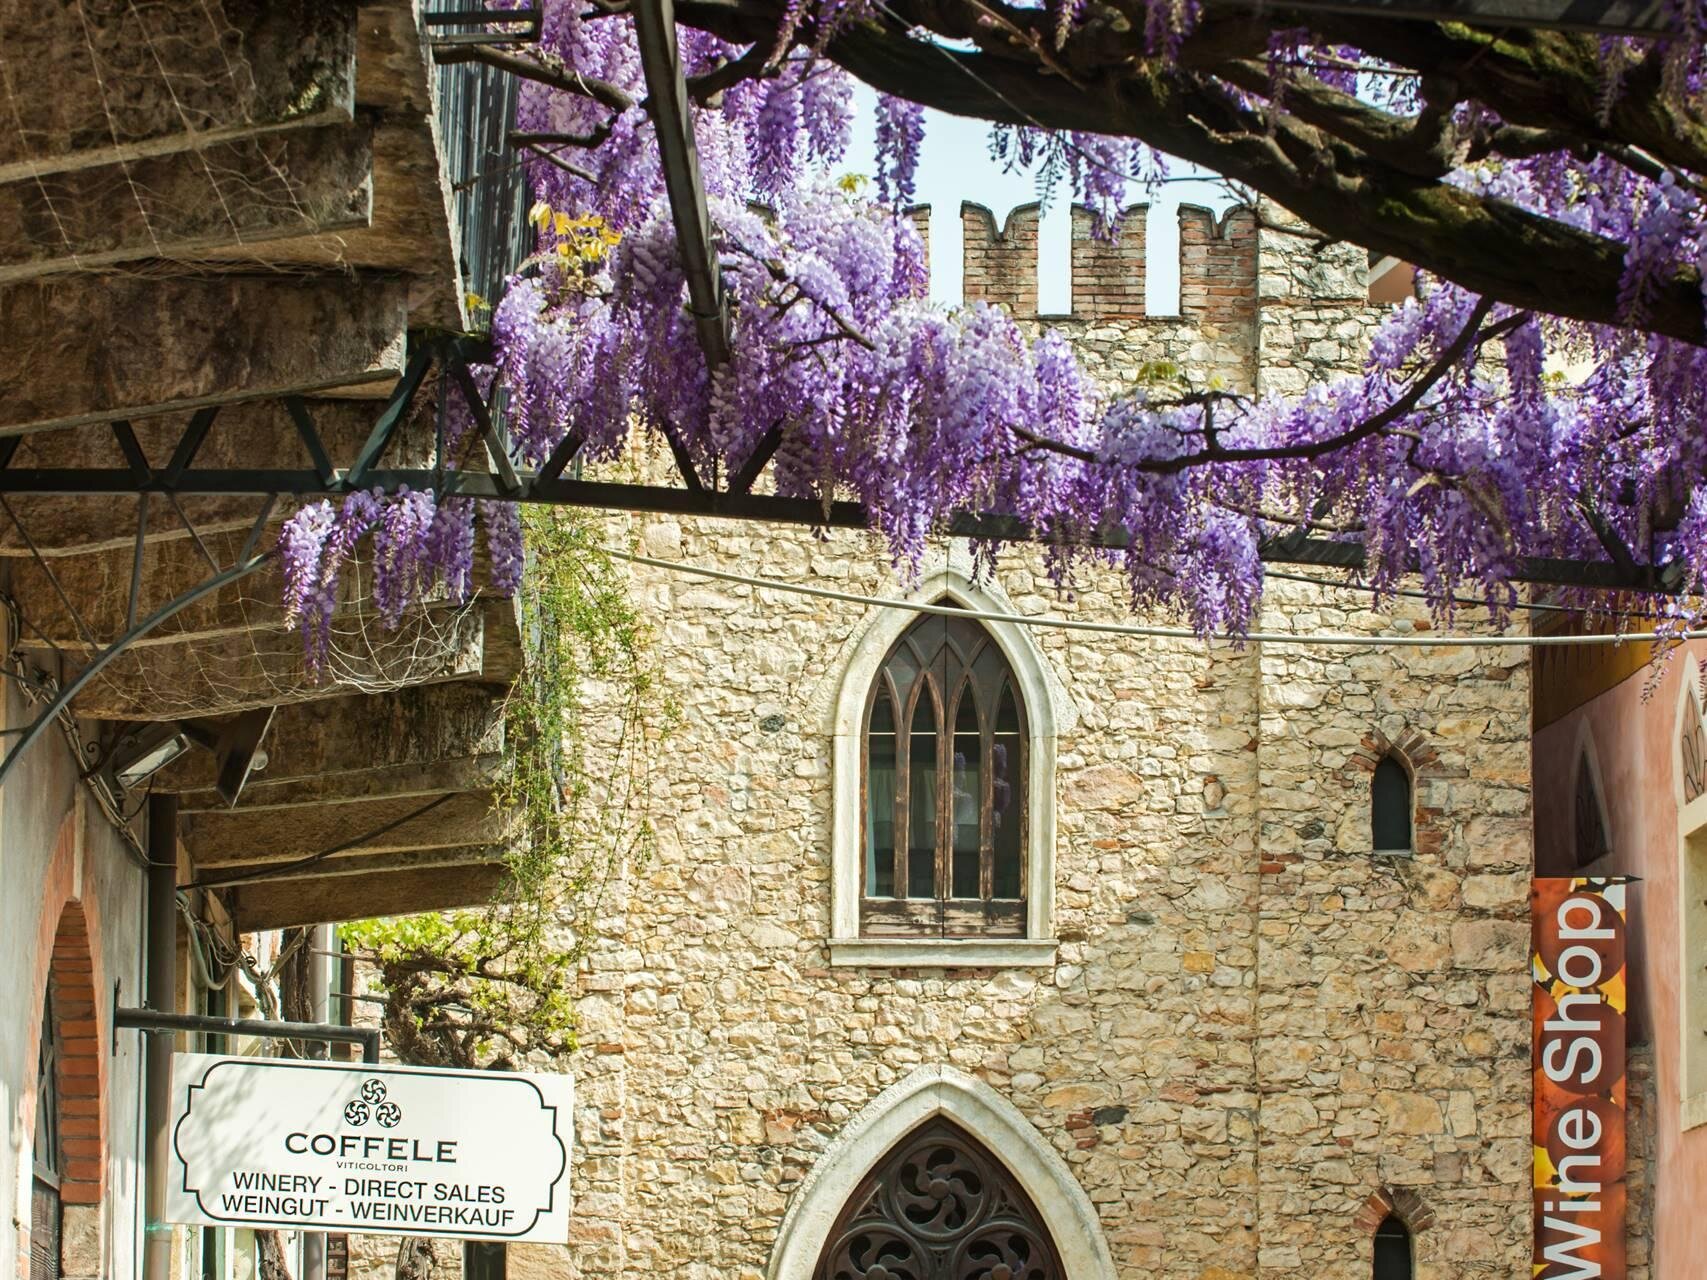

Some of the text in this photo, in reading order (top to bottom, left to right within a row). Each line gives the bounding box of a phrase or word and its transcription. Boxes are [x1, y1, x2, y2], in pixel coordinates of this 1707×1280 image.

[1542, 897, 1616, 1280] Wine Shop
[284, 1132, 458, 1164] COFFELE
[336, 1161, 408, 1172] VITICOLTORI
[233, 1171, 323, 1194] WINERY
[344, 1178, 428, 1200] DIRECT
[433, 1183, 506, 1204] SALES
[222, 1194, 329, 1217] WEINGUT
[350, 1201, 515, 1228] WEINVERKAUF
